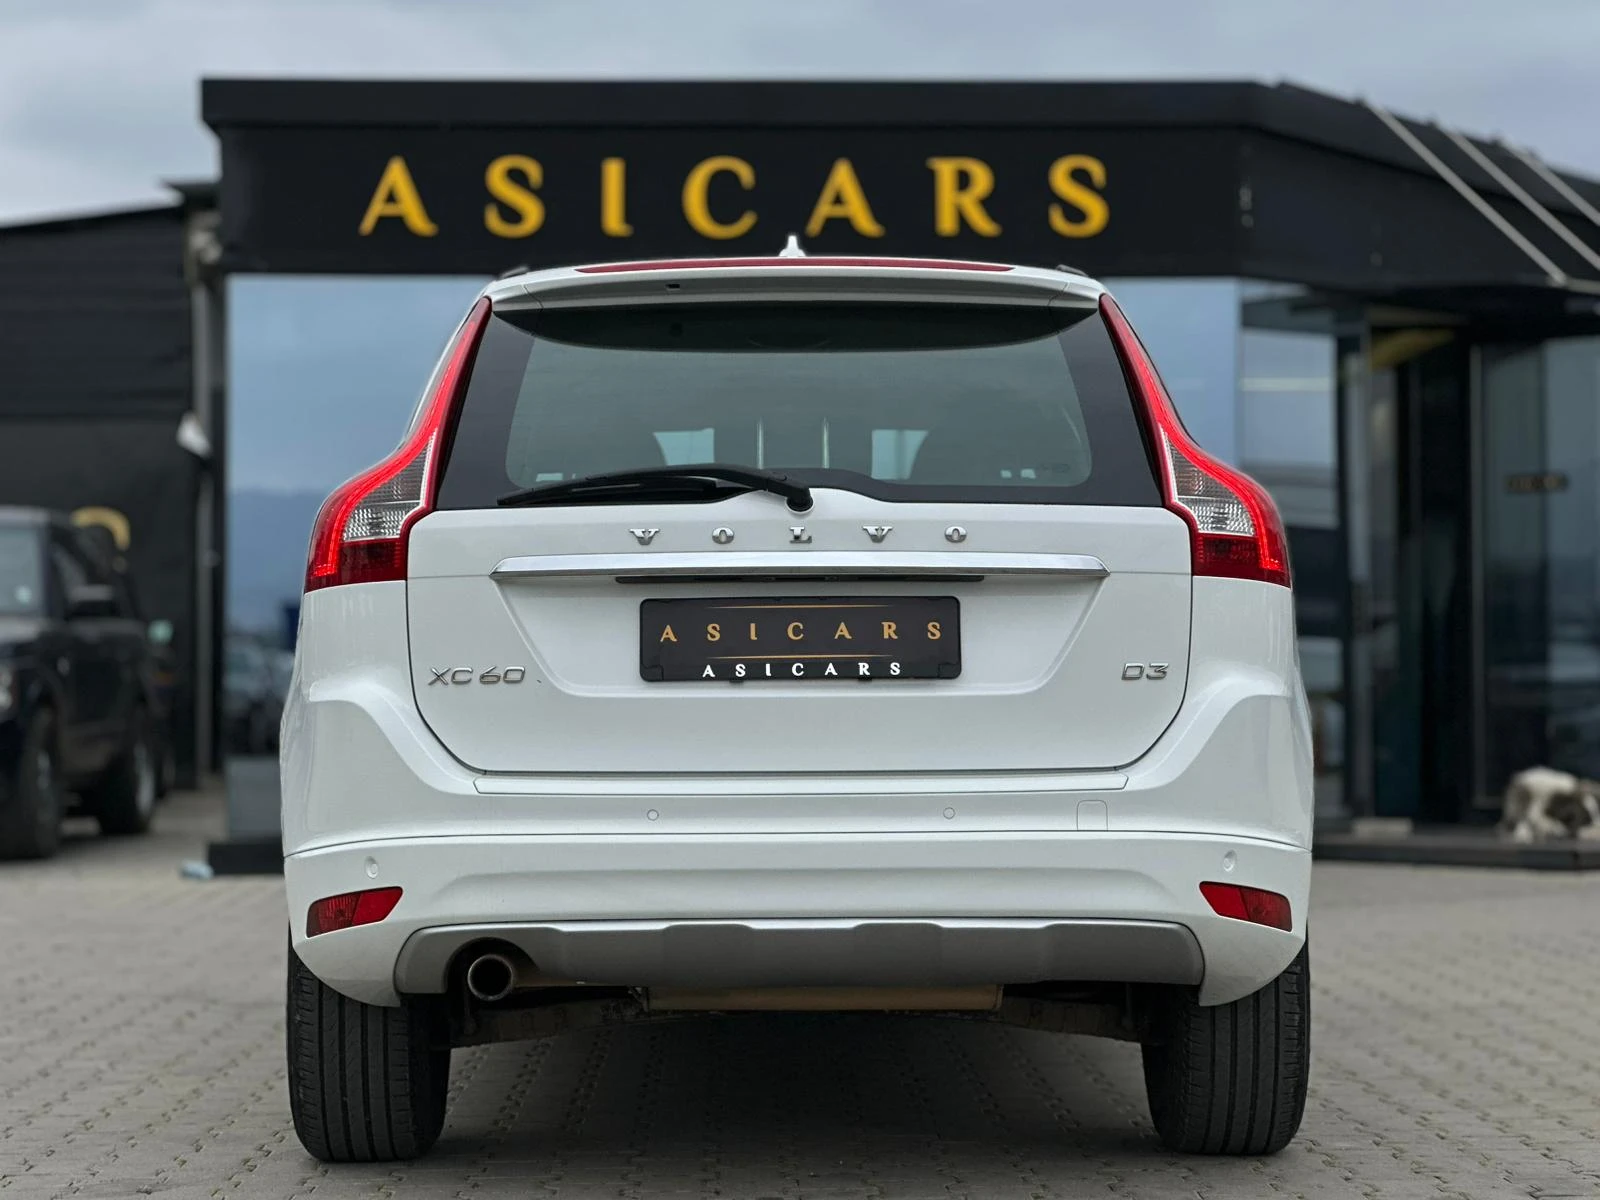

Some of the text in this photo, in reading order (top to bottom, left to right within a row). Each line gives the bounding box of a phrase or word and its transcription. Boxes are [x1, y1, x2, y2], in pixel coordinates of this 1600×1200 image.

[359, 155, 1110, 239] ASICARS
[629, 526, 967, 545] VOLVO
[660, 622, 941, 642] ASICARS
[702, 662, 901, 678] ASICARS
[1121, 663, 1168, 680] D3
